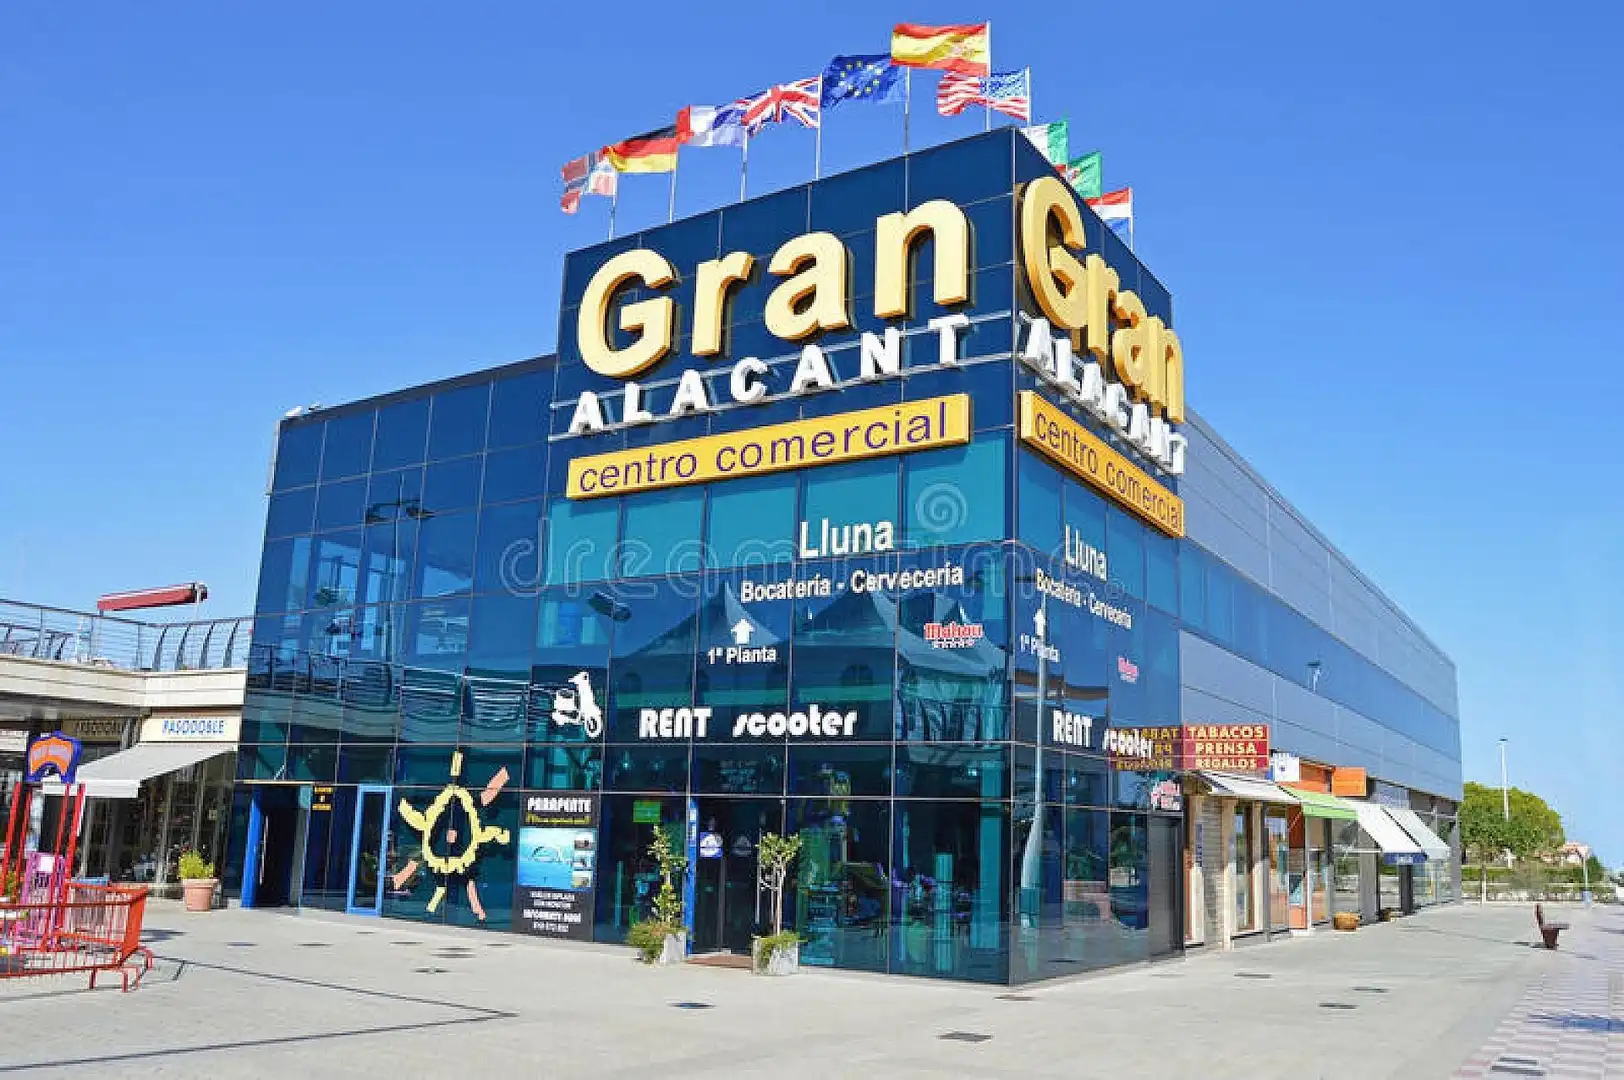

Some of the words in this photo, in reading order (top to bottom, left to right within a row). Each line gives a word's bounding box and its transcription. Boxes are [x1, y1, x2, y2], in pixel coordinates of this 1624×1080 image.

[578, 200, 970, 378] Gran
[1022, 176, 1184, 423] Gran
[568, 314, 970, 434] ALACANT
[579, 452, 697, 492] centro
[715, 401, 946, 472] comercial
[1034, 411, 1099, 475] centro
[1105, 460, 1181, 530] comercial
[801, 518, 894, 558] Lluna
[1065, 524, 1107, 581] Lluna
[741, 573, 831, 604] Bocatería
[850, 562, 964, 593] Cervecería
[726, 645, 777, 664] Planta
[639, 708, 712, 738] RENT
[732, 705, 858, 737] scooter
[1053, 709, 1093, 748] RENT
[1187, 726, 1264, 739] TABACOS
[1195, 741, 1258, 755] PRENSA
[1195, 757, 1258, 769] REGALOS
